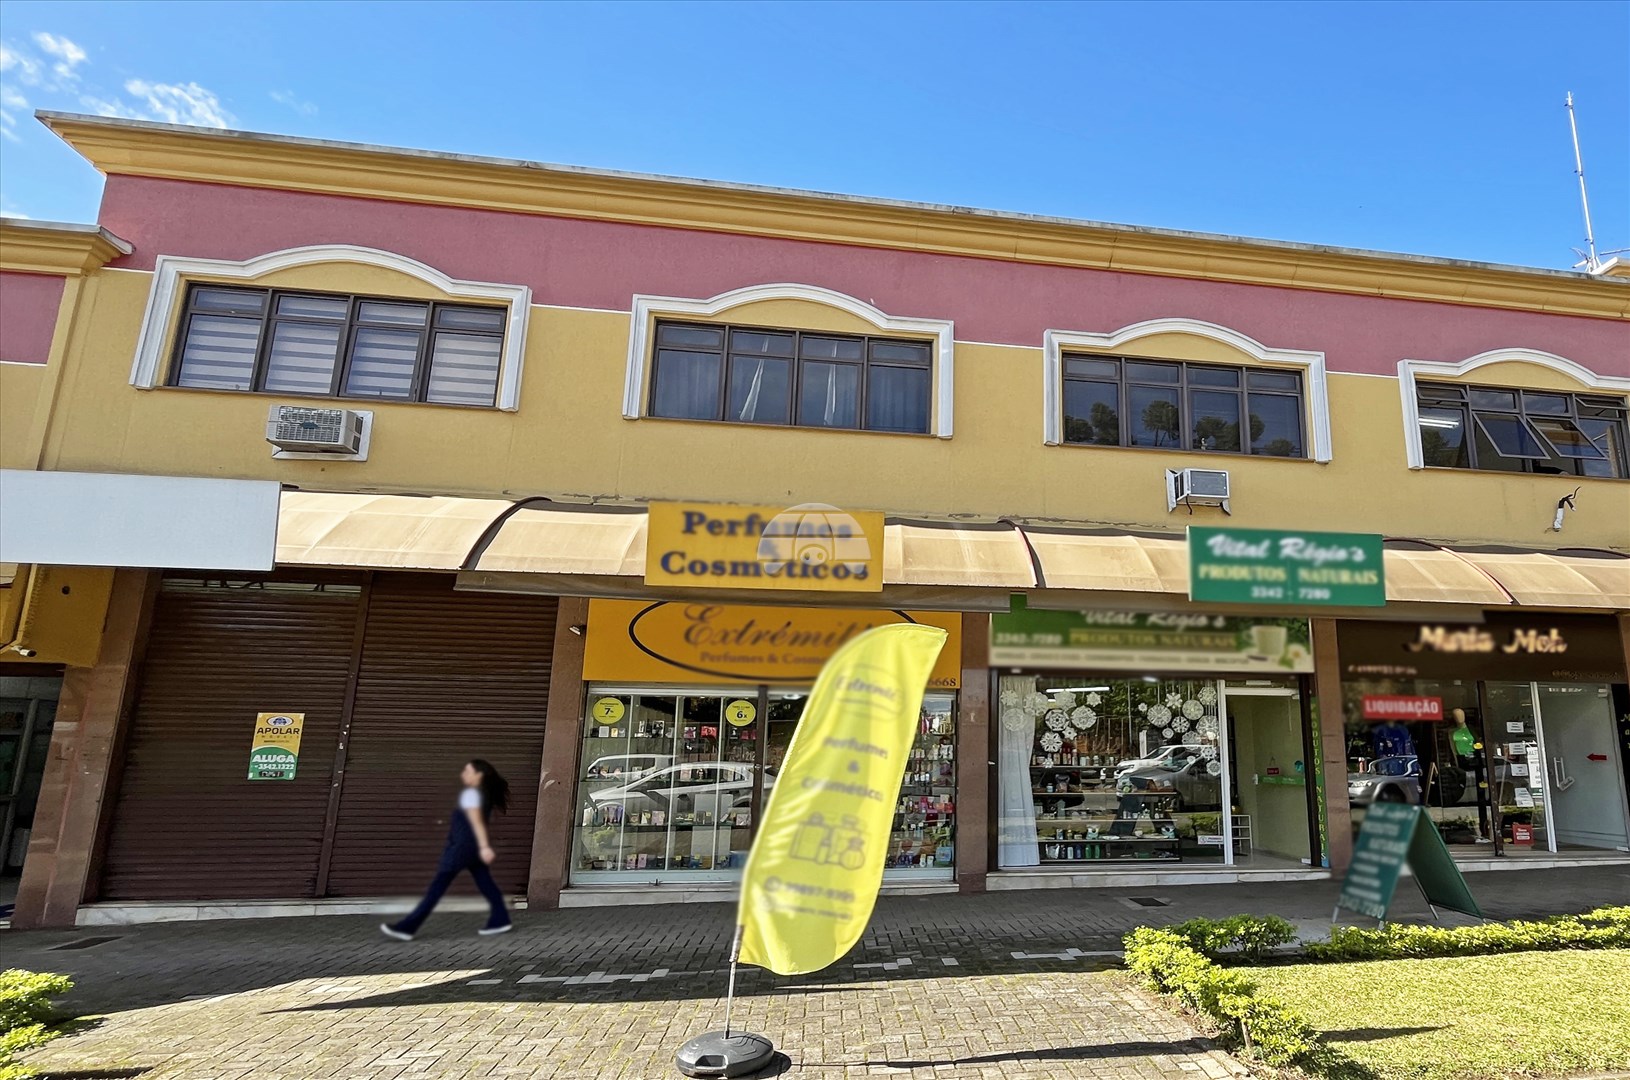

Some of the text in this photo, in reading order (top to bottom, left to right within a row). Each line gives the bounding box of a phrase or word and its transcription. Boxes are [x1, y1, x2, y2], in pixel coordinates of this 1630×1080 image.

[681, 510, 853, 539] Perfumes
[1206, 533, 1271, 559] Vital
[1199, 563, 1379, 585] PRODUTOS NATURAIS
[1069, 632, 1157, 645] PRODUTOS
[1160, 634, 1238, 649] NATURAIS
[700, 651, 764, 664] Perfumes
[767, 653, 778, 664] &
[1365, 698, 1439, 717] LIQUIDAÇÃO
[252, 754, 295, 763] ALUGA
